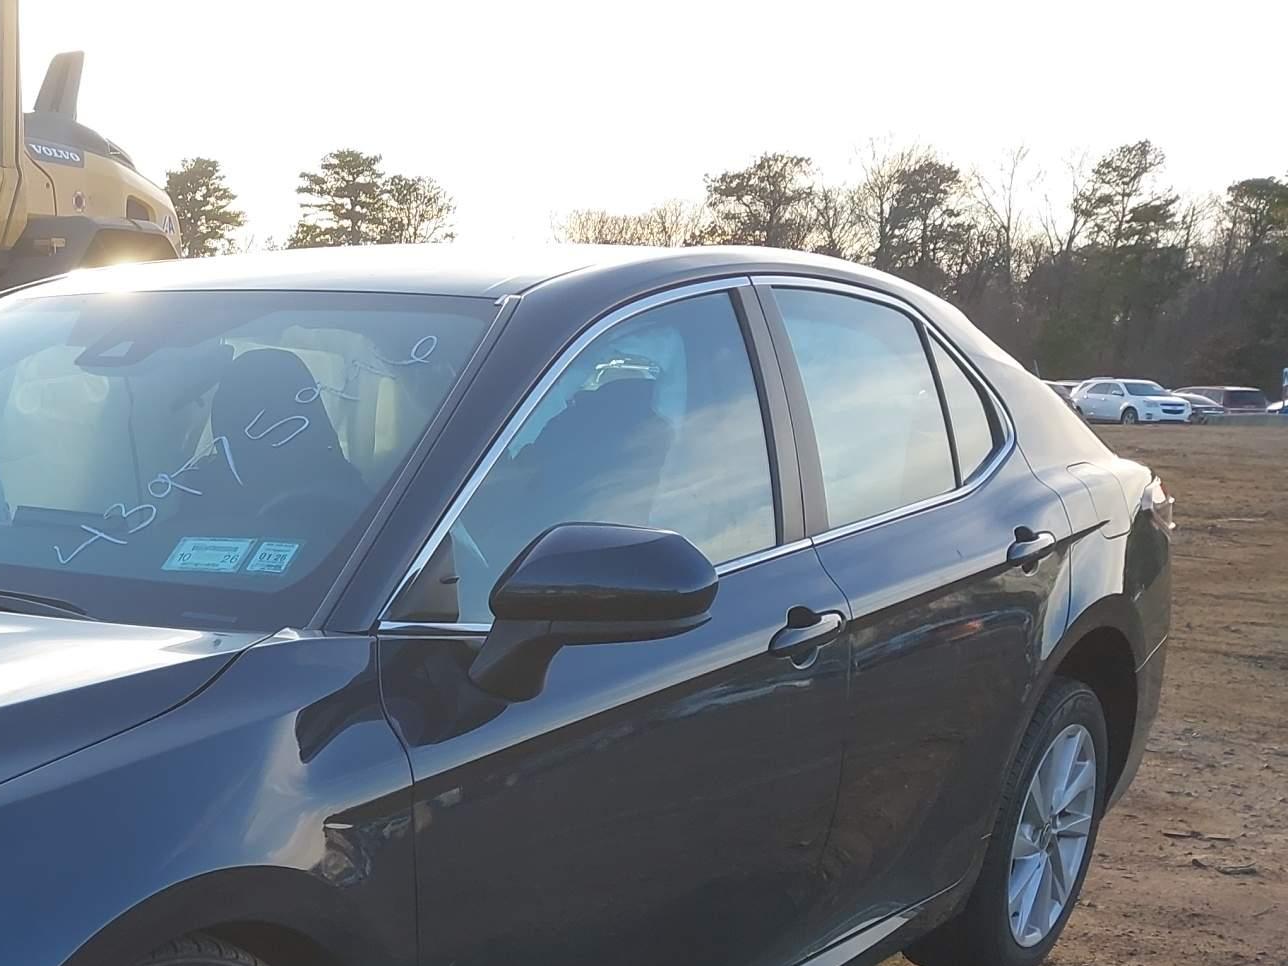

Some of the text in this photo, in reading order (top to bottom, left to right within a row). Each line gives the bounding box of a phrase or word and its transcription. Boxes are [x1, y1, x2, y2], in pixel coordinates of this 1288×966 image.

[28, 143, 81, 162] VOLVO
[177, 552, 240, 564] 10 26
